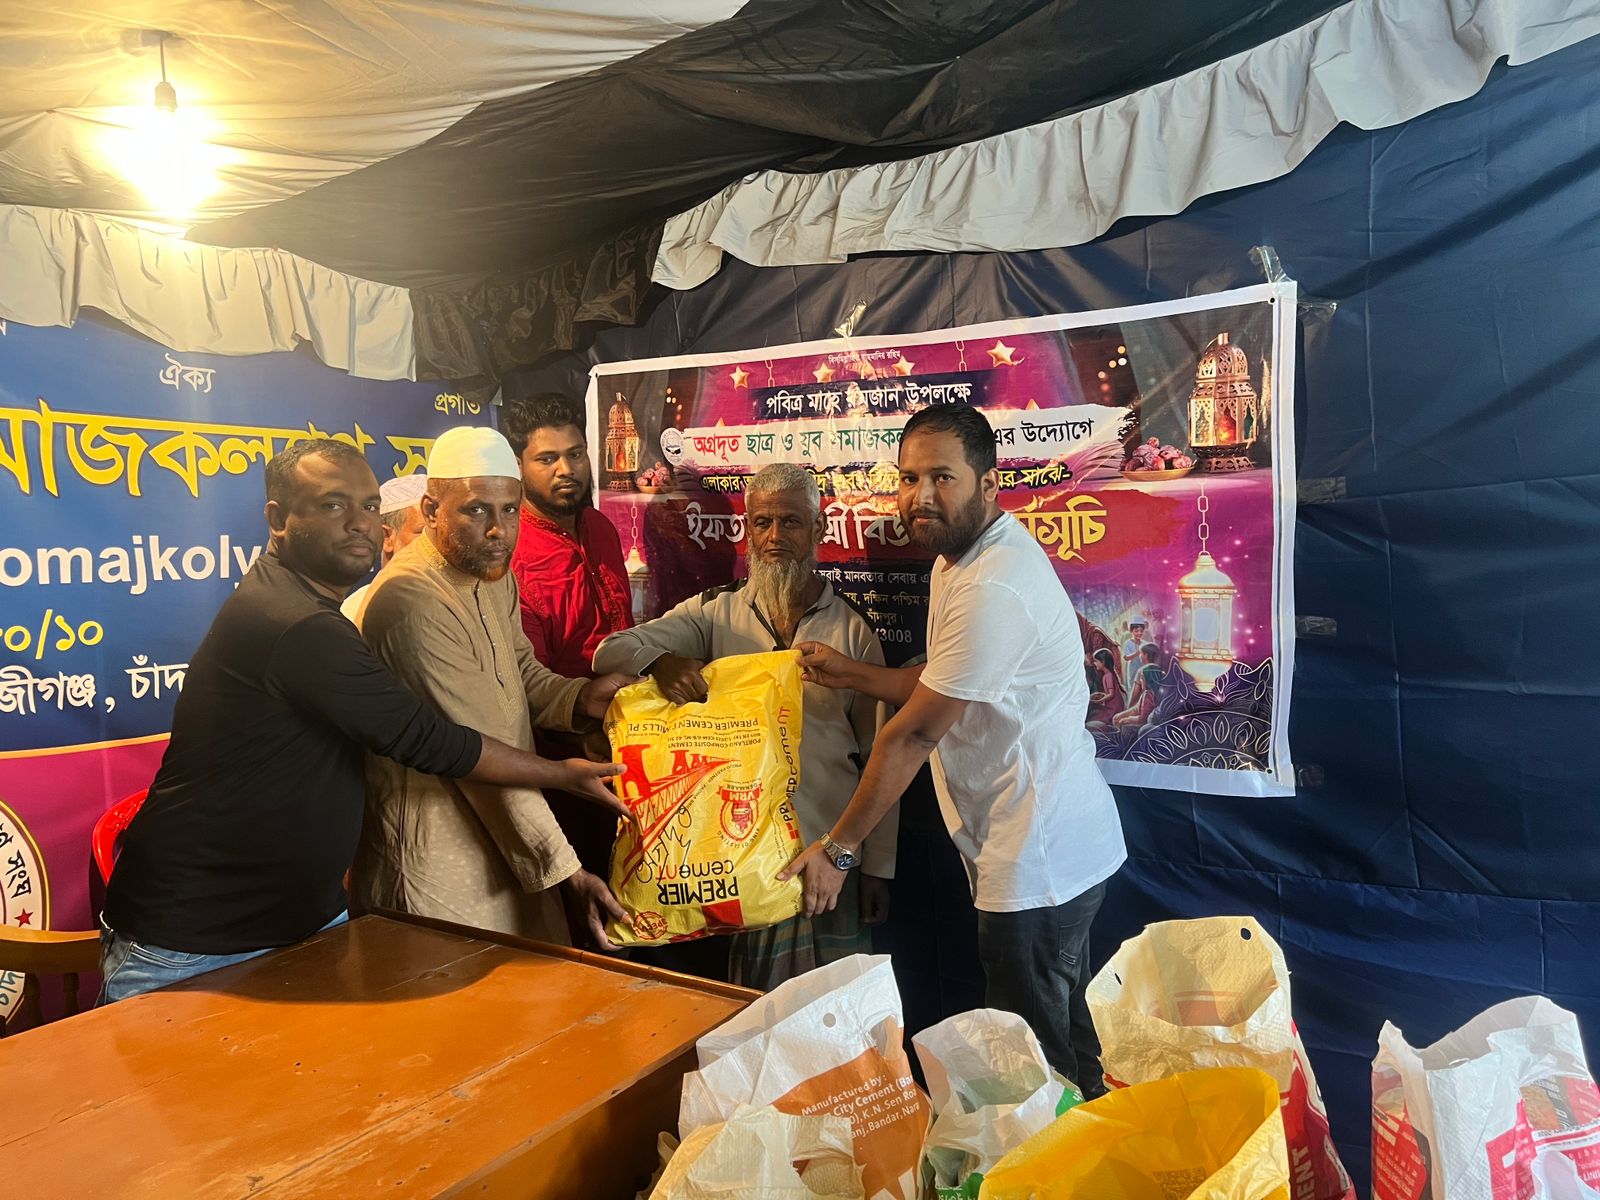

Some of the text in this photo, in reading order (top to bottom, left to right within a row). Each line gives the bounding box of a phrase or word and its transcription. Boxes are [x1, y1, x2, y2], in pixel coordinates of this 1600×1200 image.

[159, 353, 216, 393] ঐক্য
[766, 389, 802, 415] পবিত্র
[807, 388, 842, 413] মাহে
[904, 380, 973, 407] উপলক্ষে
[693, 434, 742, 462] অগ্রদূত
[745, 430, 776, 457] ছাত্র
[780, 432, 794, 452] ও
[800, 430, 825, 457] যুব
[1020, 417, 1095, 443] উদ্যোগে
[701, 473, 742, 493] এলাকার
[0, 609, 104, 660] ০/১০
[124, 654, 190, 700] চাঁদ
[642, 723, 670, 734] MILLS
[672, 720, 713, 730] CEMENT
[714, 717, 759, 731] PREMIER
[693, 741, 729, 749] COMPOSITE
[728, 738, 761, 748] PORTLAND
[729, 791, 755, 801] VRM
[5, 849, 32, 899] সংঘ
[657, 876, 740, 906] PREMIER
[801, 1081, 871, 1116] Manufactured
[833, 1101, 855, 1117] City
[856, 1083, 895, 1107] Cement
[884, 1095, 903, 1110] Sen
[867, 1112, 903, 1132] Bandar,
